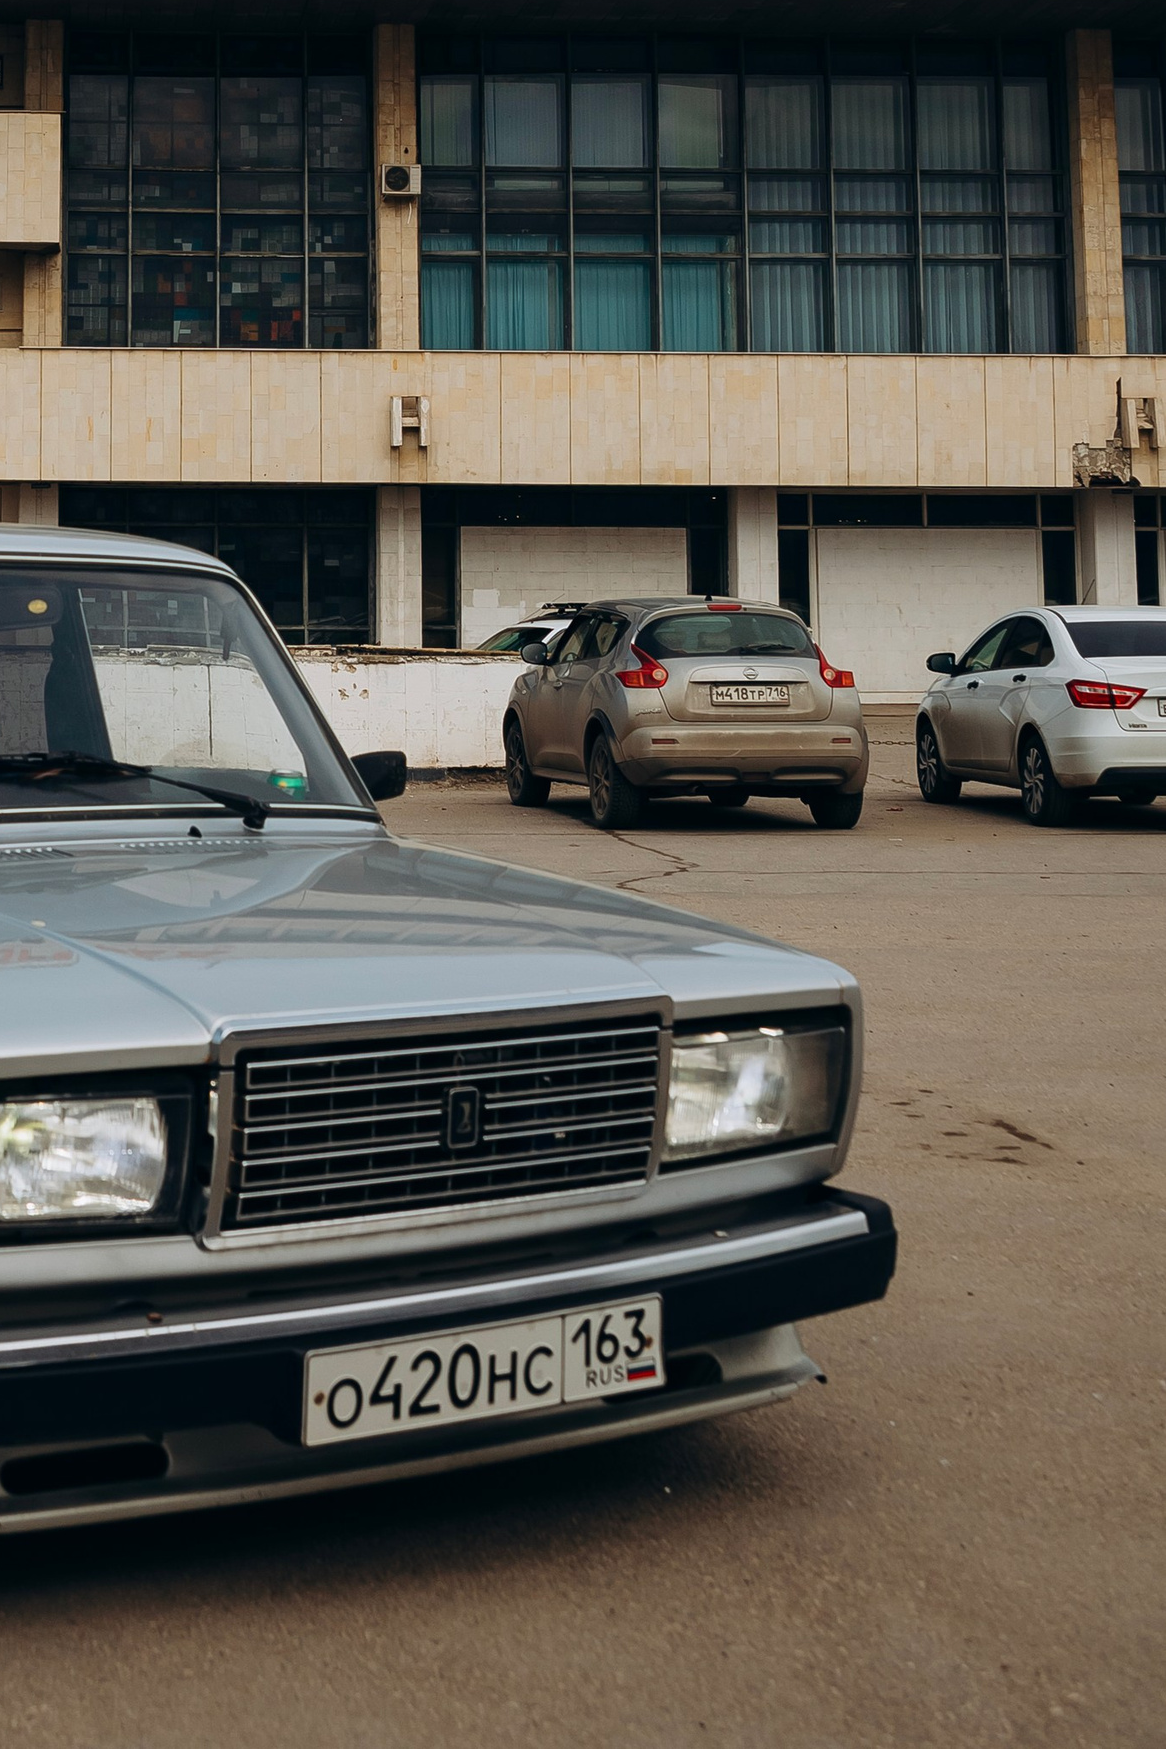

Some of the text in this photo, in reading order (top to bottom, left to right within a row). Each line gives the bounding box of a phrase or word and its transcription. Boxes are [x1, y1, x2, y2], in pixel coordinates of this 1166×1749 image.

[766, 687, 786, 697] 716
[326, 1308, 647, 1429] О420НС 163
[585, 1361, 625, 1389] RUS
